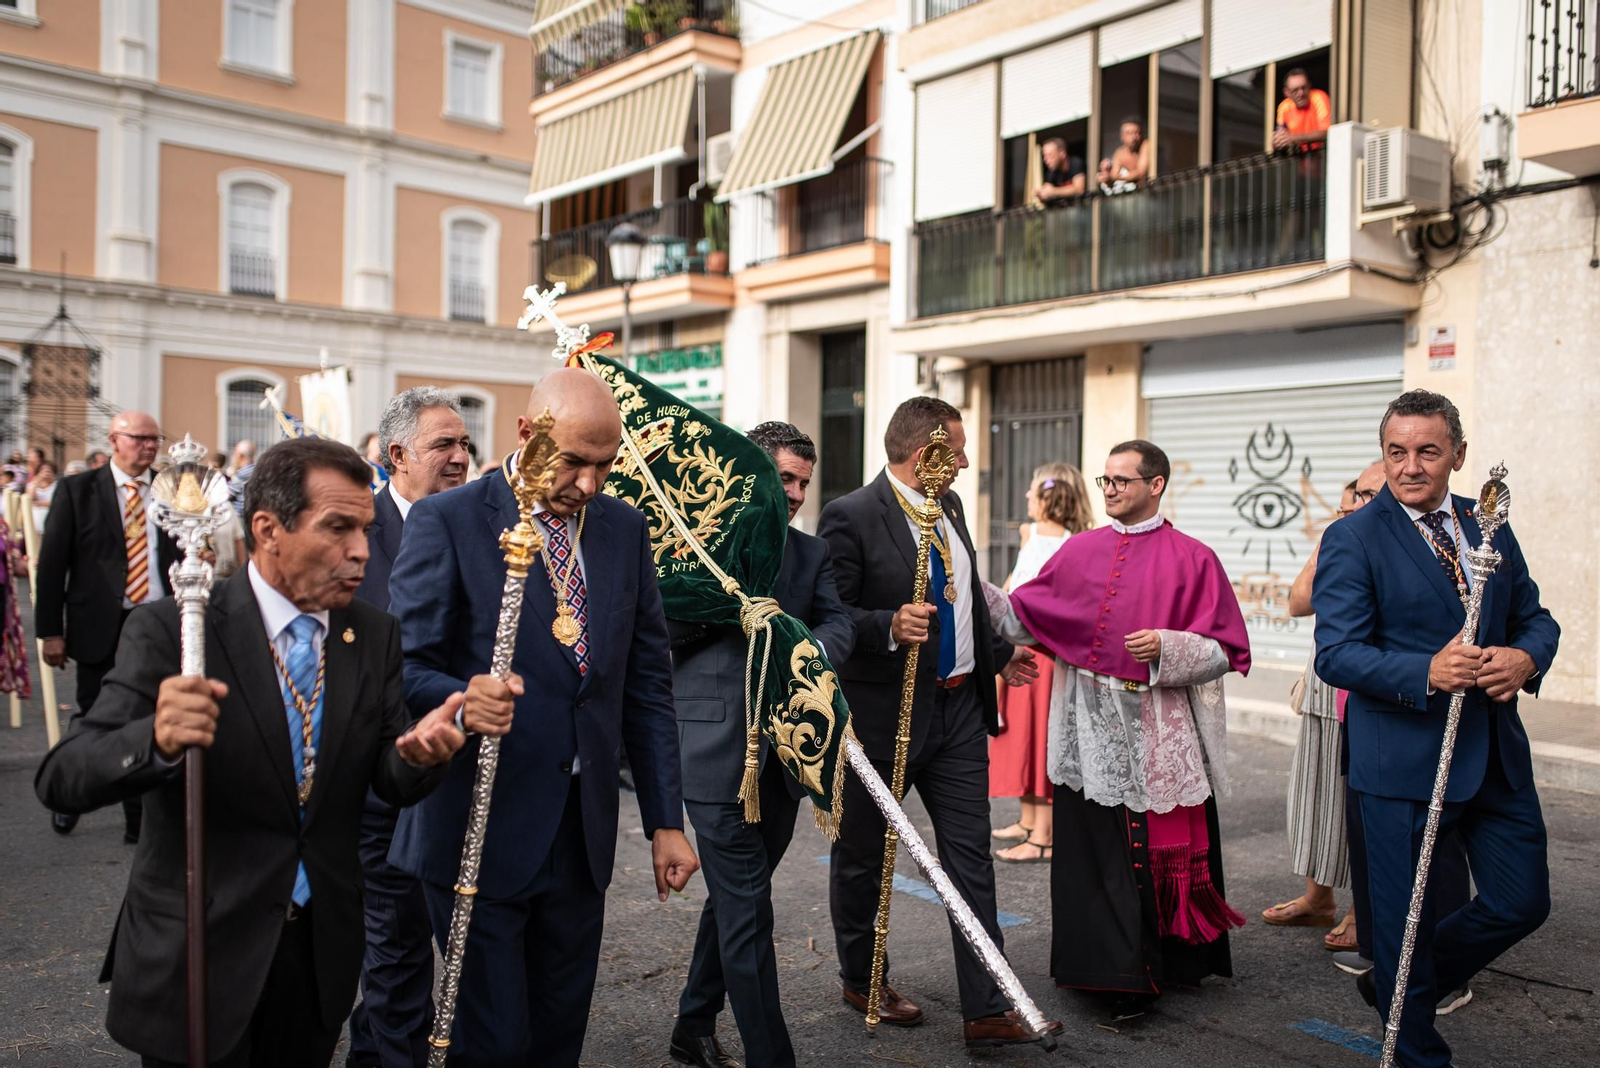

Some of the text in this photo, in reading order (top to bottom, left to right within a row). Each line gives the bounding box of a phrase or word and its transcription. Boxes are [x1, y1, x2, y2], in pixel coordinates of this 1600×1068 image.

[636, 405, 691, 425] DE HUELVA
[655, 565, 667, 578] DE
[709, 530, 730, 553] SRA.
[729, 505, 746, 525] DEL
